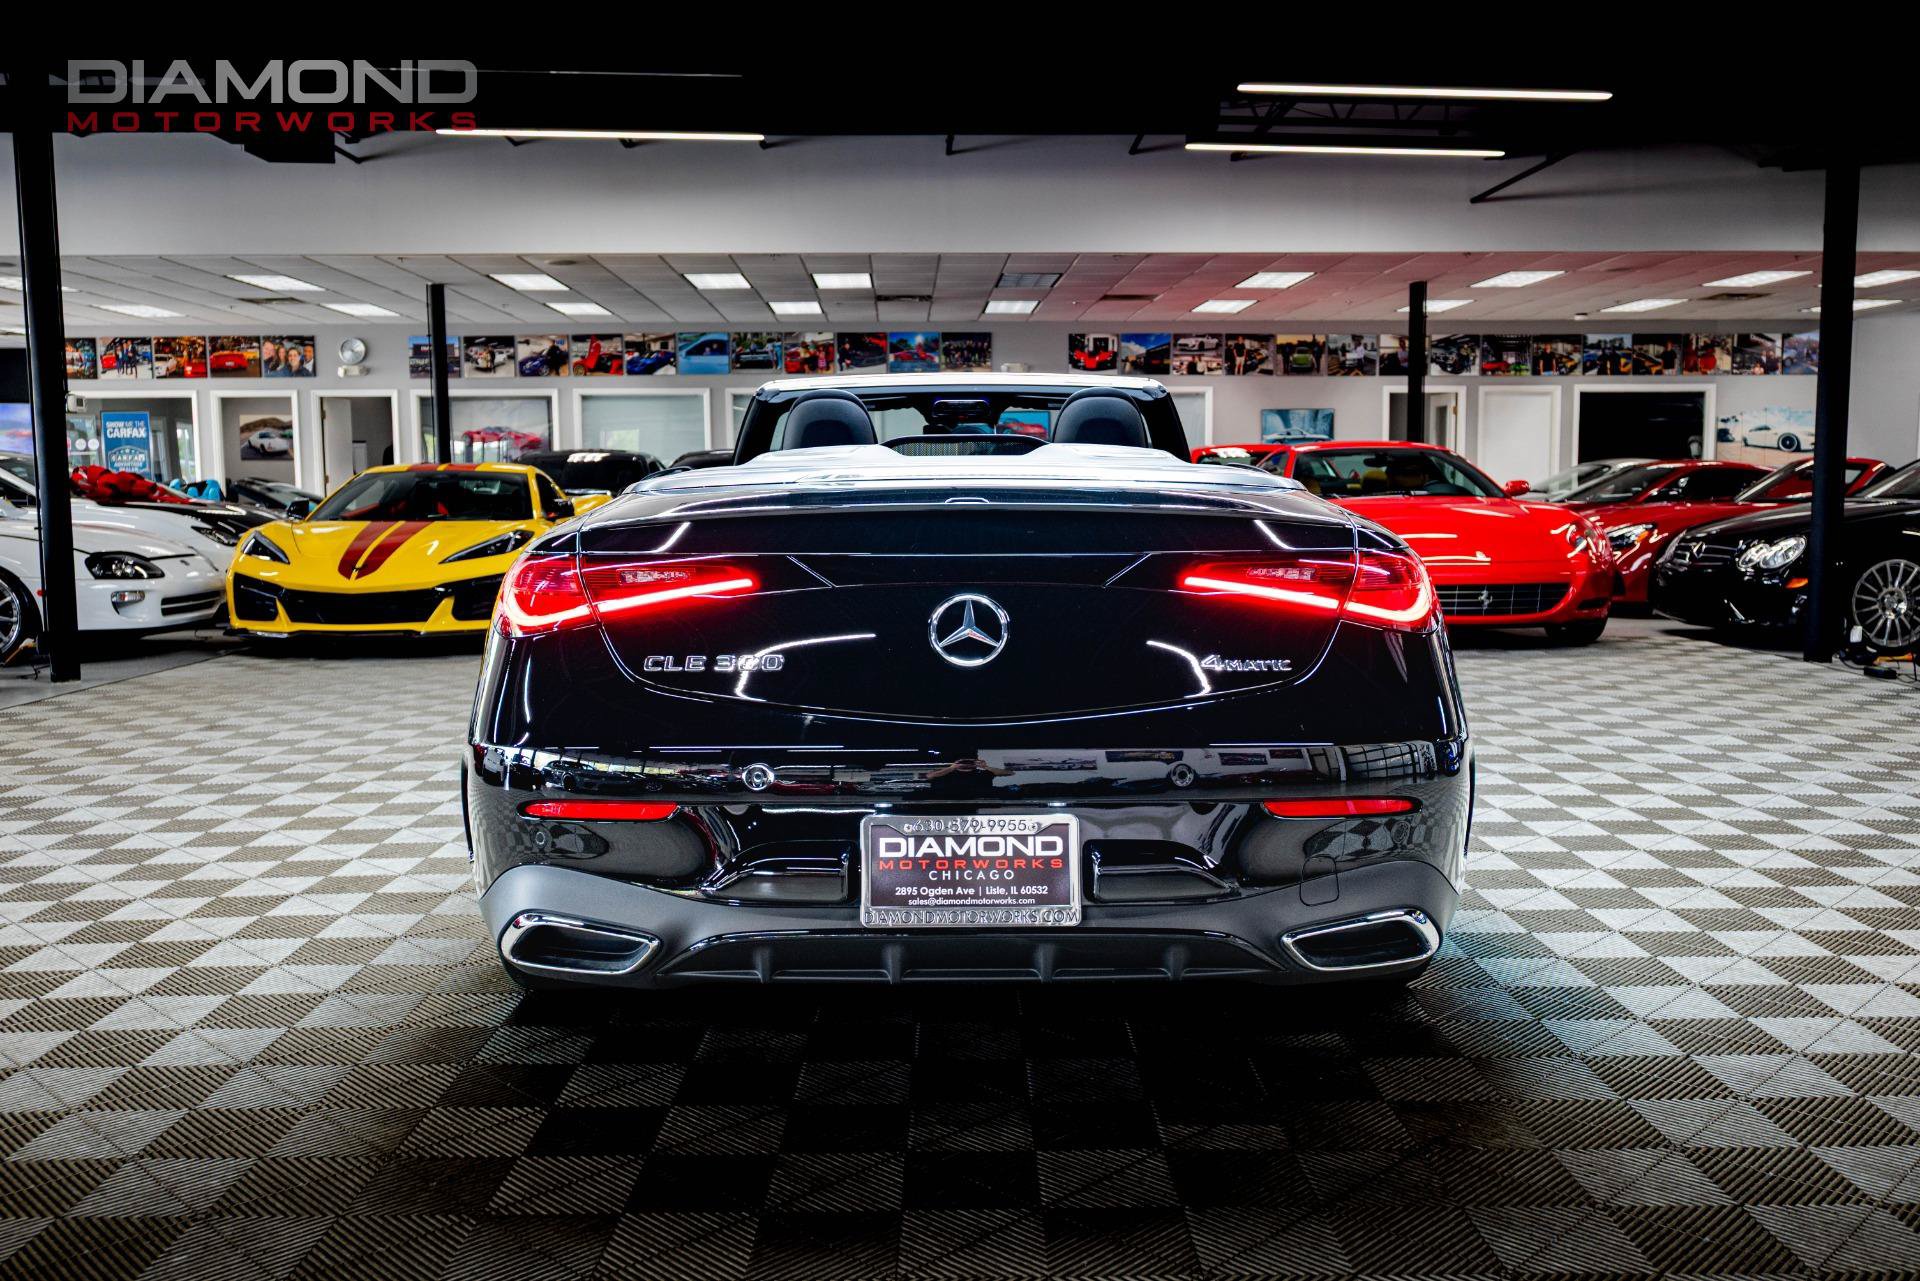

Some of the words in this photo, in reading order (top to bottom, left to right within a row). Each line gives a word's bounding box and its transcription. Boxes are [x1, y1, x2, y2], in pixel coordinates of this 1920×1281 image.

[107, 428, 147, 438] CARFAX
[643, 655, 707, 672] CLE
[713, 654, 785, 672] 300
[1200, 655, 1293, 671] 4MATIC
[879, 836, 1063, 858] DIAMOND
[879, 859, 1063, 870] MOTORWORKS
[928, 870, 1015, 881] CHICAGO
[895, 886, 918, 896] 2895
[920, 886, 954, 897] Ogden
[955, 886, 976, 895] Ave
[985, 886, 1008, 896] Lisle,
[1010, 886, 1019, 895] IL
[1020, 885, 1049, 895] 60532
[908, 897, 1036, 906] sales@diamondmotorworks.com
[865, 909, 1079, 925] DIAMONDMOTORWORKS.COM
